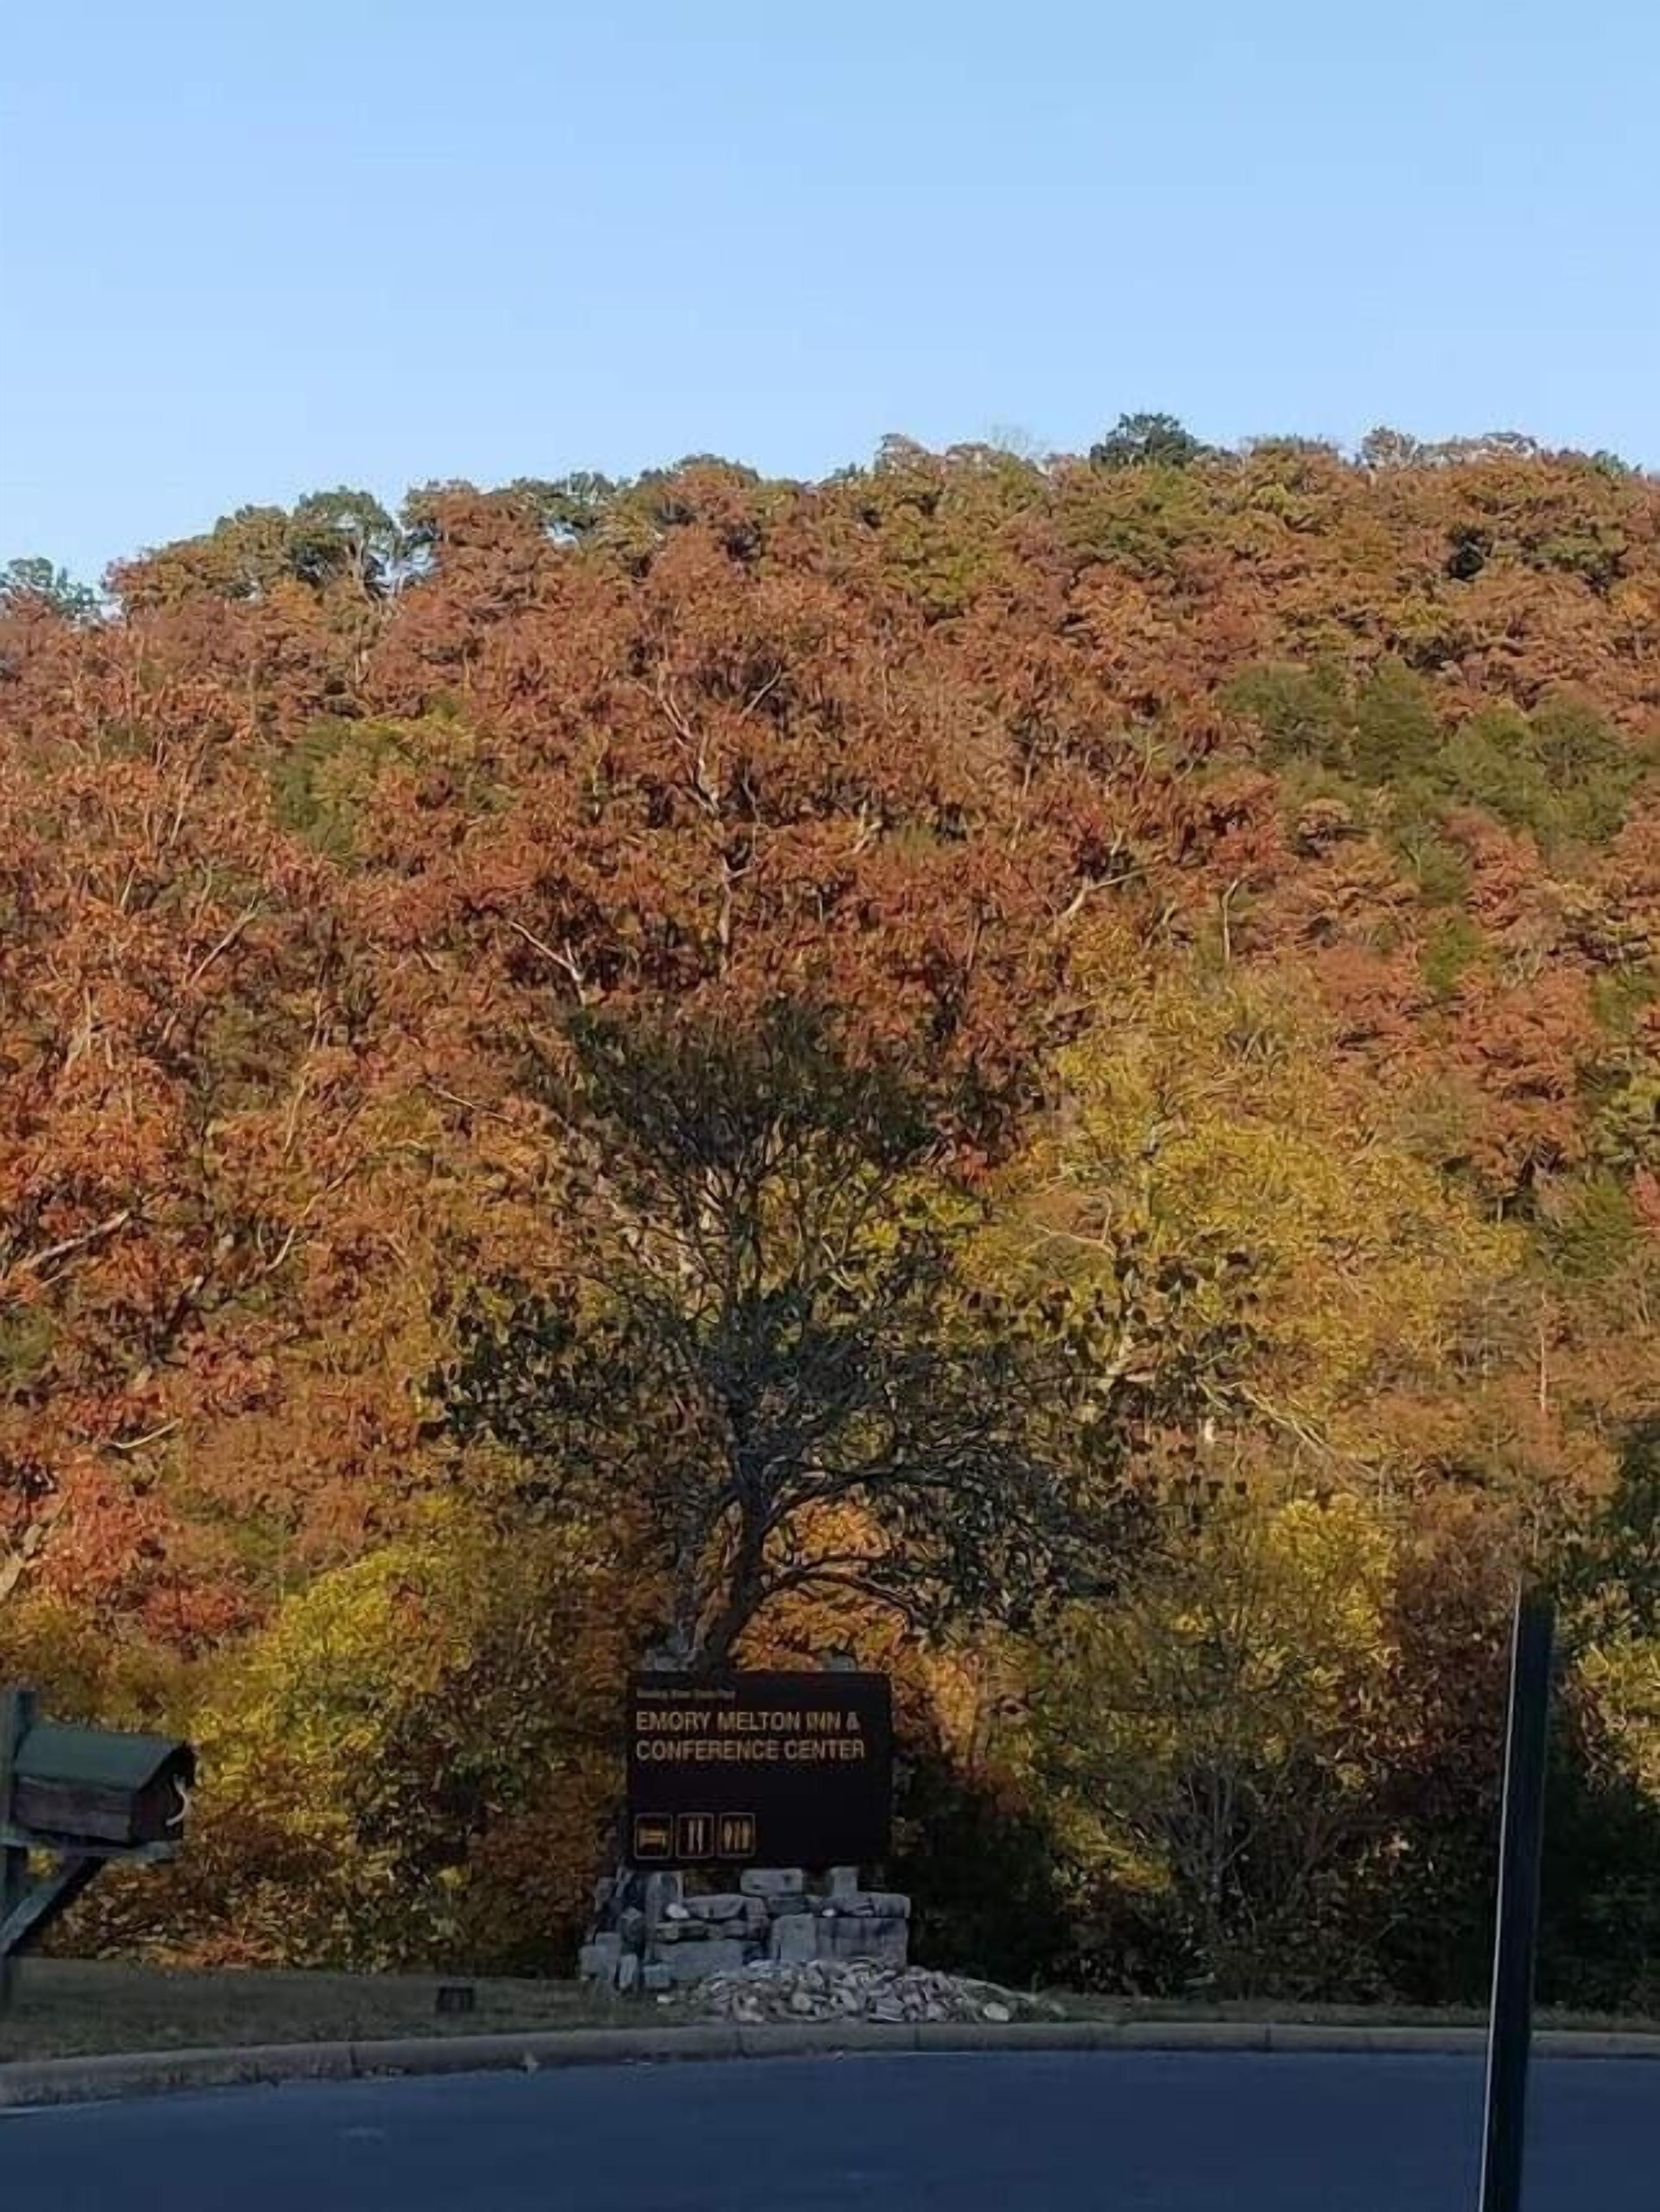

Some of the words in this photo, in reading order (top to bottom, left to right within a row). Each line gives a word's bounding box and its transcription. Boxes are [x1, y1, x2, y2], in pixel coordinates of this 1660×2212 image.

[636, 1711, 711, 1731] EMORY
[717, 1711, 800, 1731] MELTON
[806, 1711, 841, 1731] INN
[636, 1740, 779, 1761] CONFERENCE
[784, 1740, 865, 1760] CENTER
